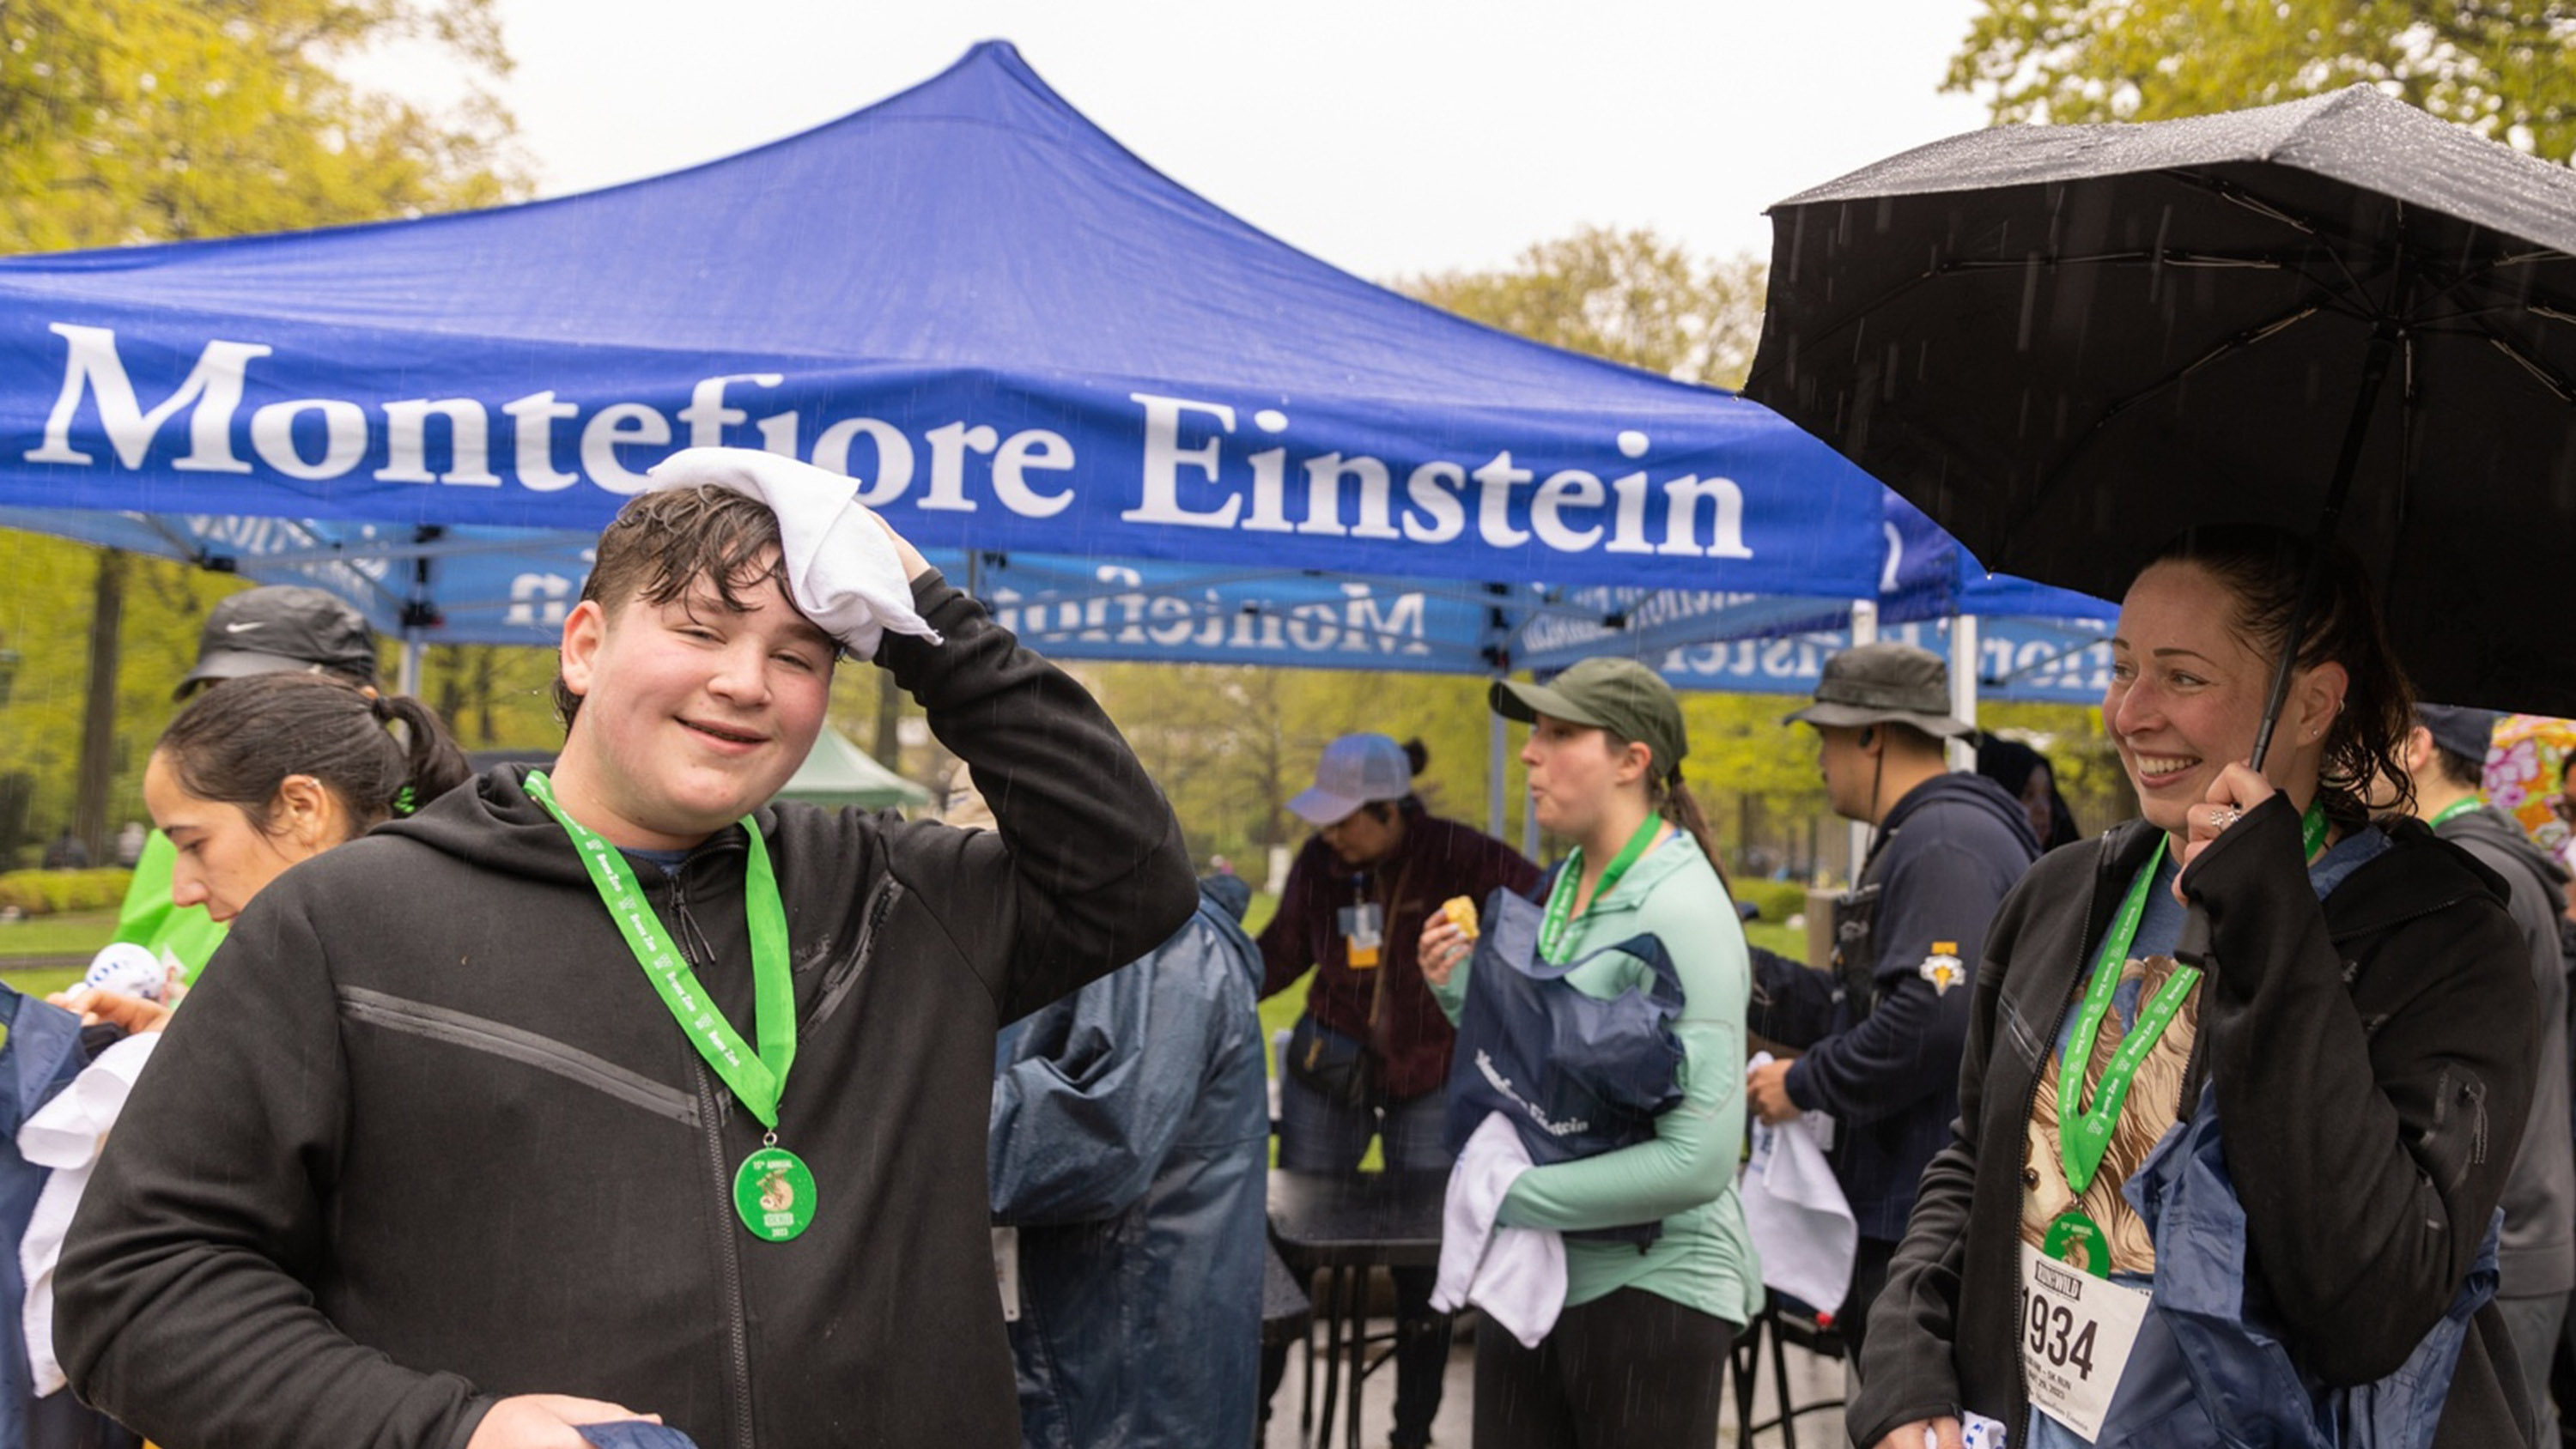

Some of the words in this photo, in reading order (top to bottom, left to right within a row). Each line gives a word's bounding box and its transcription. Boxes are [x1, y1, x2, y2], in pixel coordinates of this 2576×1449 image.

[24, 323, 1075, 518] Montefiore
[1121, 392, 1753, 560] Einstein
[597, 853, 614, 878] Bronx
[630, 913, 647, 938] Bronx
[666, 972, 684, 997] Bronx
[708, 1030, 727, 1053] Bronx
[2020, 1287, 2098, 1381] 1934
